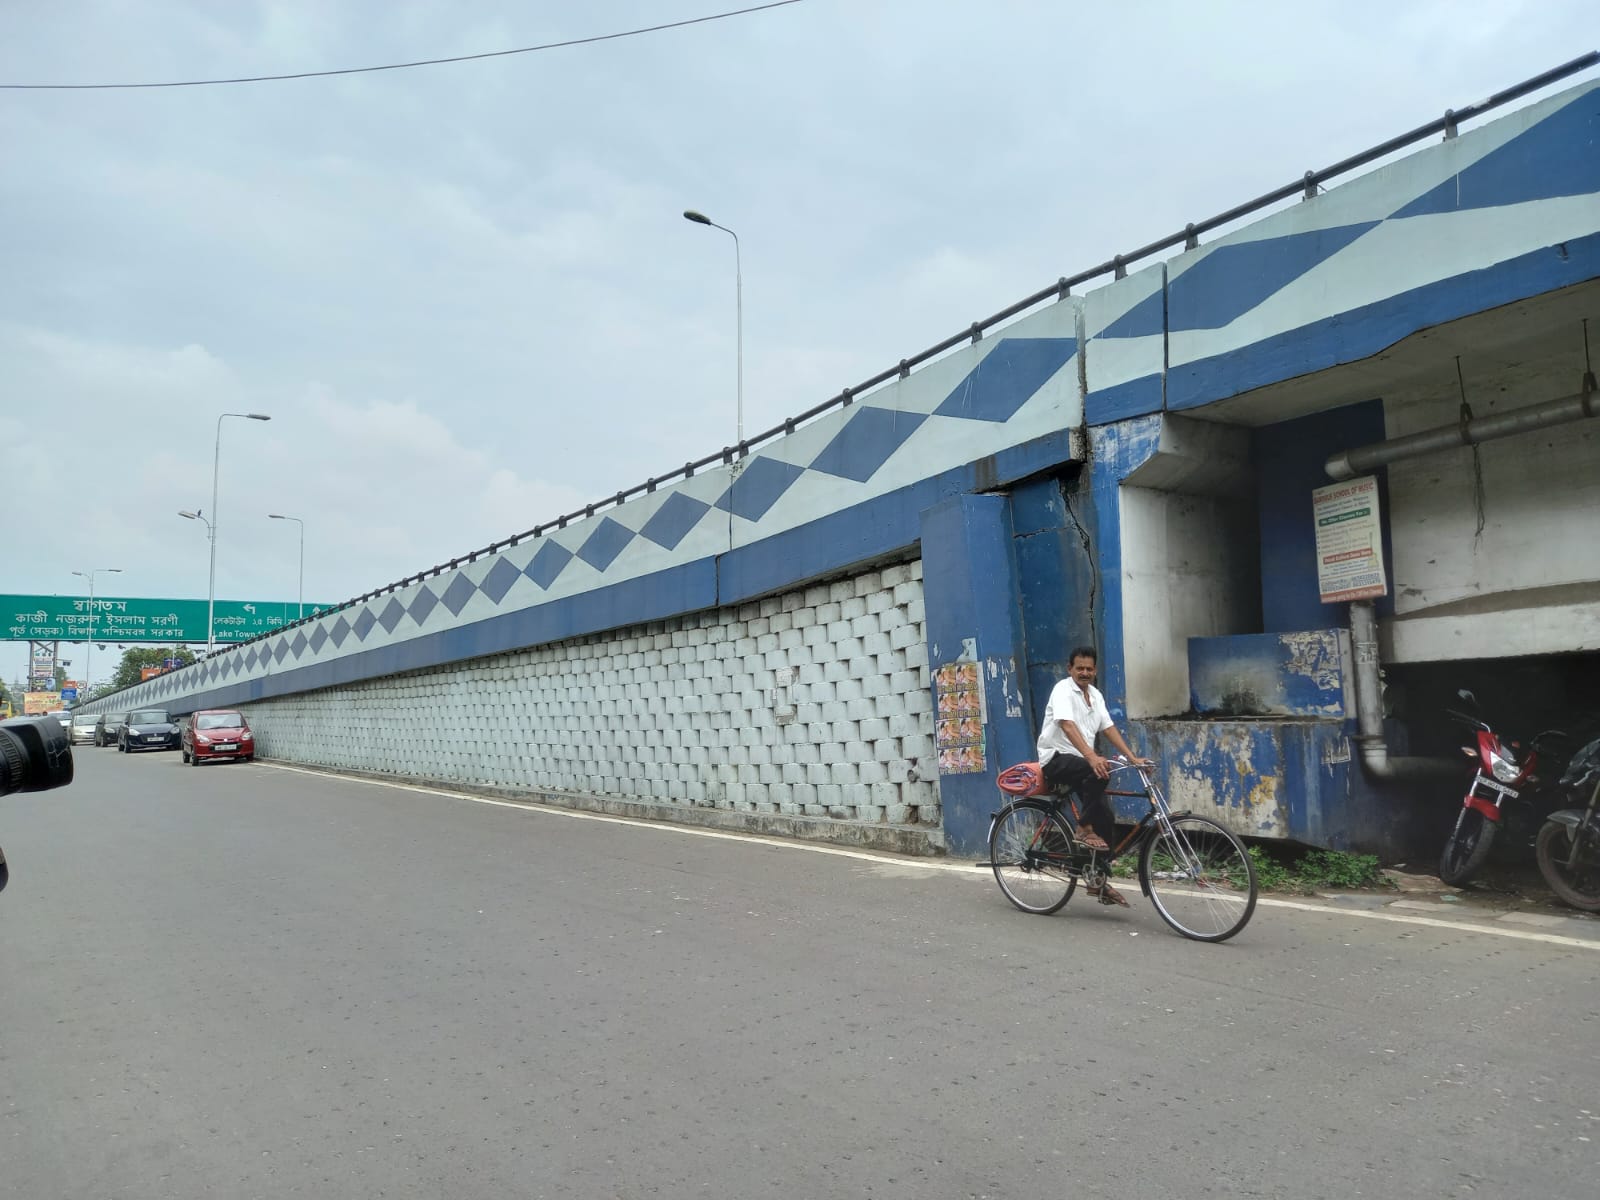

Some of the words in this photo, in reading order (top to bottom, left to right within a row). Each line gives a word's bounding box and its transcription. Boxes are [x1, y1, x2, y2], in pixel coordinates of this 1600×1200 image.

[15, 610, 48, 623] কাজী
[56, 614, 101, 624] নজরুল
[106, 612, 146, 625] ইসলাম
[151, 613, 178, 626] সরণী
[151, 628, 184, 637] সরকার
[213, 629, 233, 638] Lake
[235, 630, 256, 638] Town
